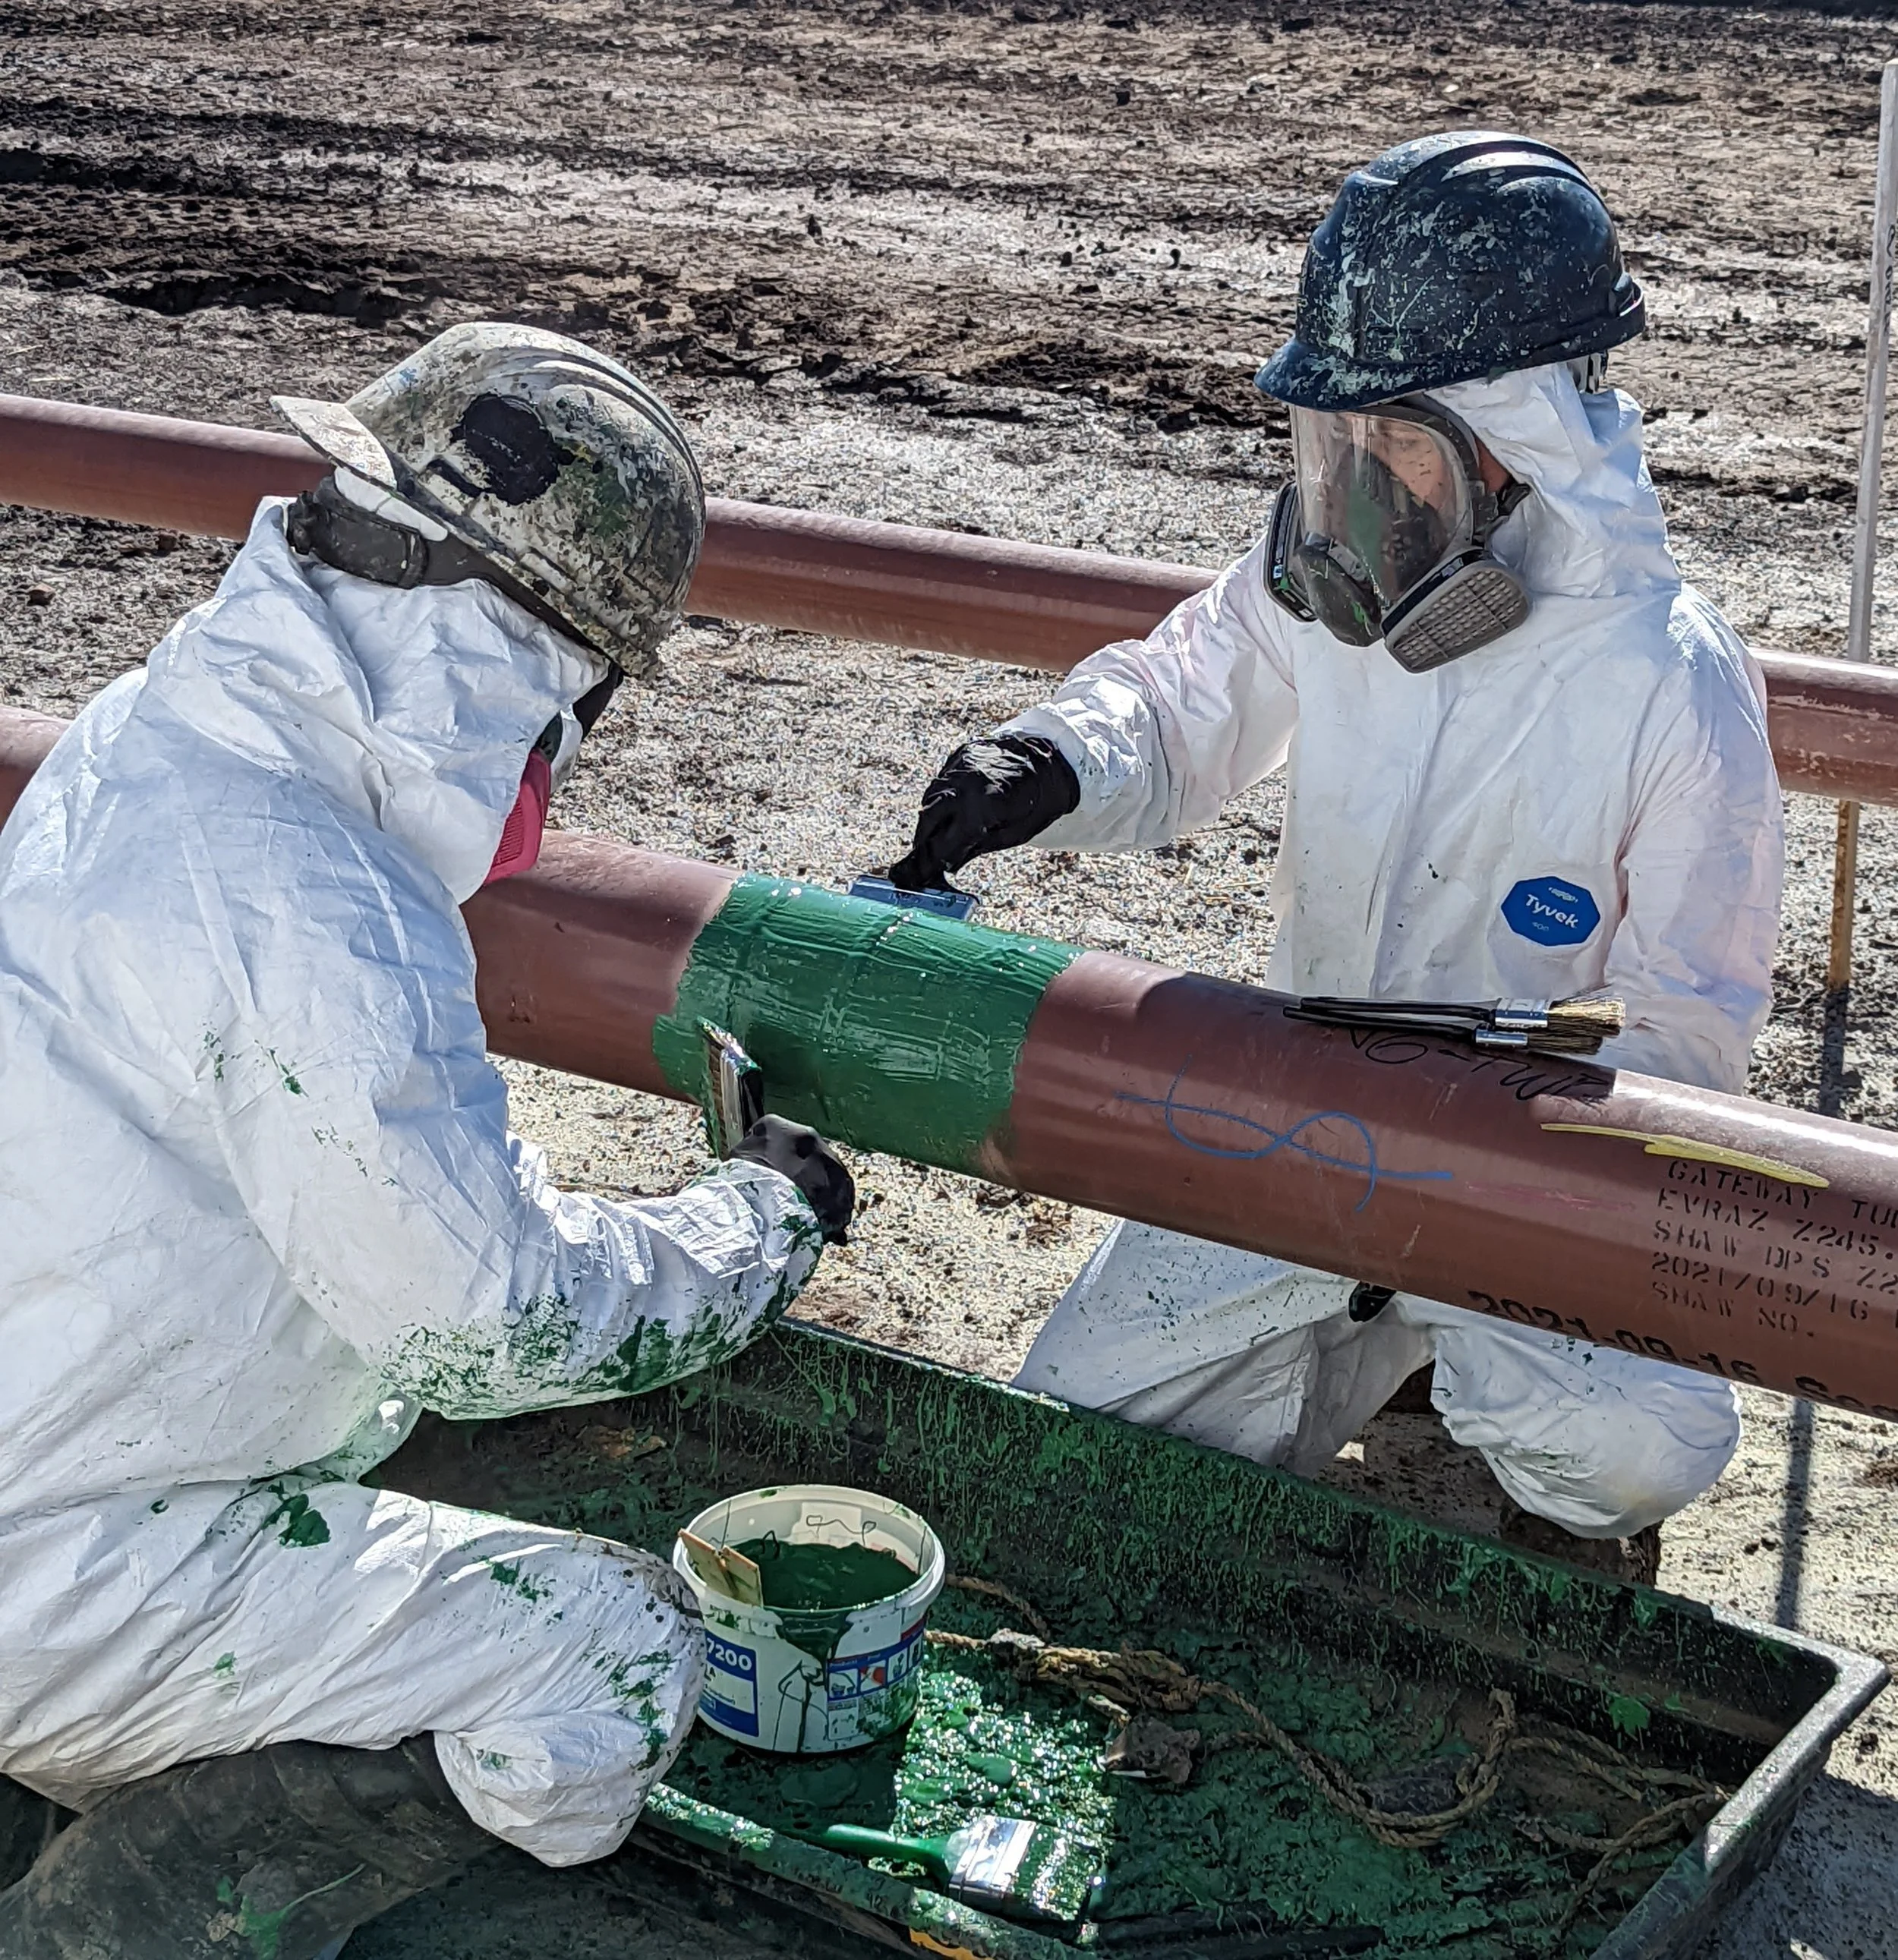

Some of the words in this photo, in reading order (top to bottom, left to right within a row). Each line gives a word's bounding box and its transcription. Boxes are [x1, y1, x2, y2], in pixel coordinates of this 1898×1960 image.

[1525, 893, 1579, 928] Tyvek
[1658, 1187, 1769, 1232] EVRAZ
[1668, 1159, 1818, 1209] GATEWAY
[1852, 1199, 1898, 1229] TU
[1654, 1219, 1741, 1257] SHAW
[1652, 1251, 1869, 1321] 2021/09/16
[1652, 1281, 1735, 1318] SHAW
[1758, 1306, 1814, 1338] NO.
[706, 1637, 753, 1671] 7200
